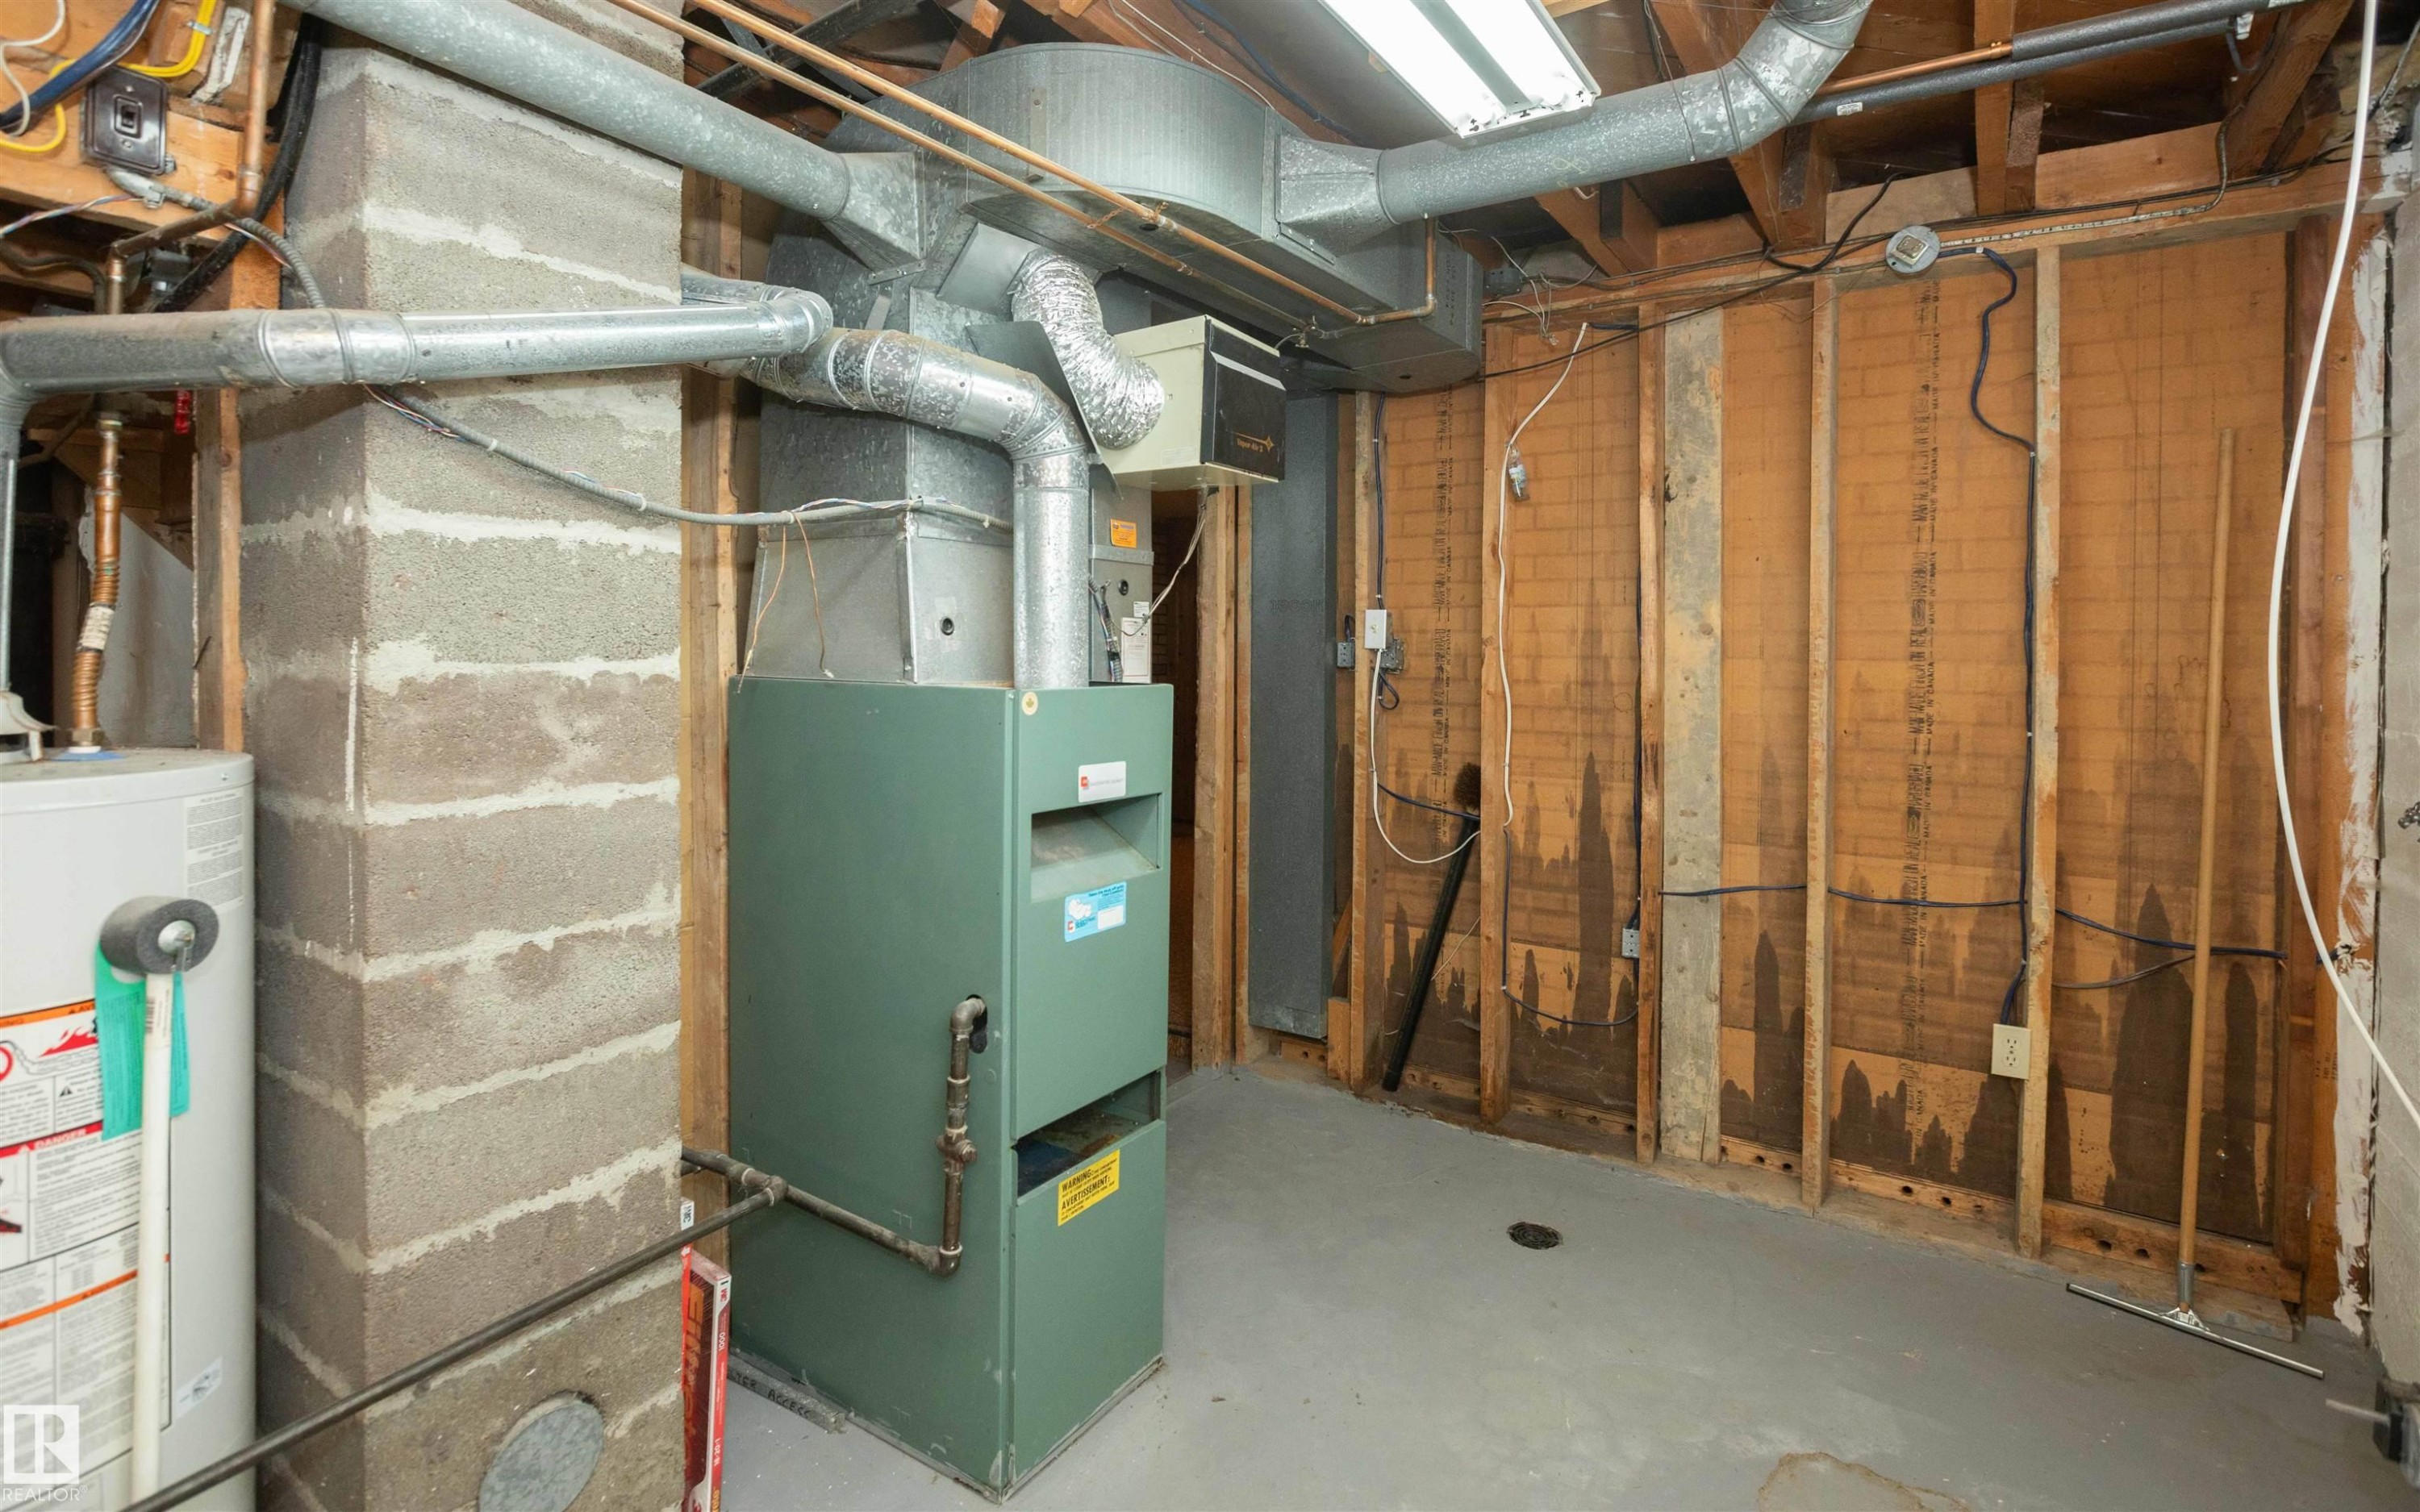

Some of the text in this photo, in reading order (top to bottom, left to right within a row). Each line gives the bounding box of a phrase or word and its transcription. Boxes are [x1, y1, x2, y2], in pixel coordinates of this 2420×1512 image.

[1930, 447, 1938, 481] CANADA
[1927, 699, 1934, 707] IN
[1926, 713, 1934, 735] MADE
[1925, 765, 1933, 798] CANADA
[1924, 802, 1931, 810] IN
[1920, 875, 1928, 904] ANADA
[34, 1128, 87, 1149] DANGER
[1062, 1168, 1094, 1193] WARNING:
[1062, 1175, 1110, 1210] AVERTISSEMENT:
[728, 1365, 757, 1390] LTER
[767, 1389, 810, 1419] ACCESS
